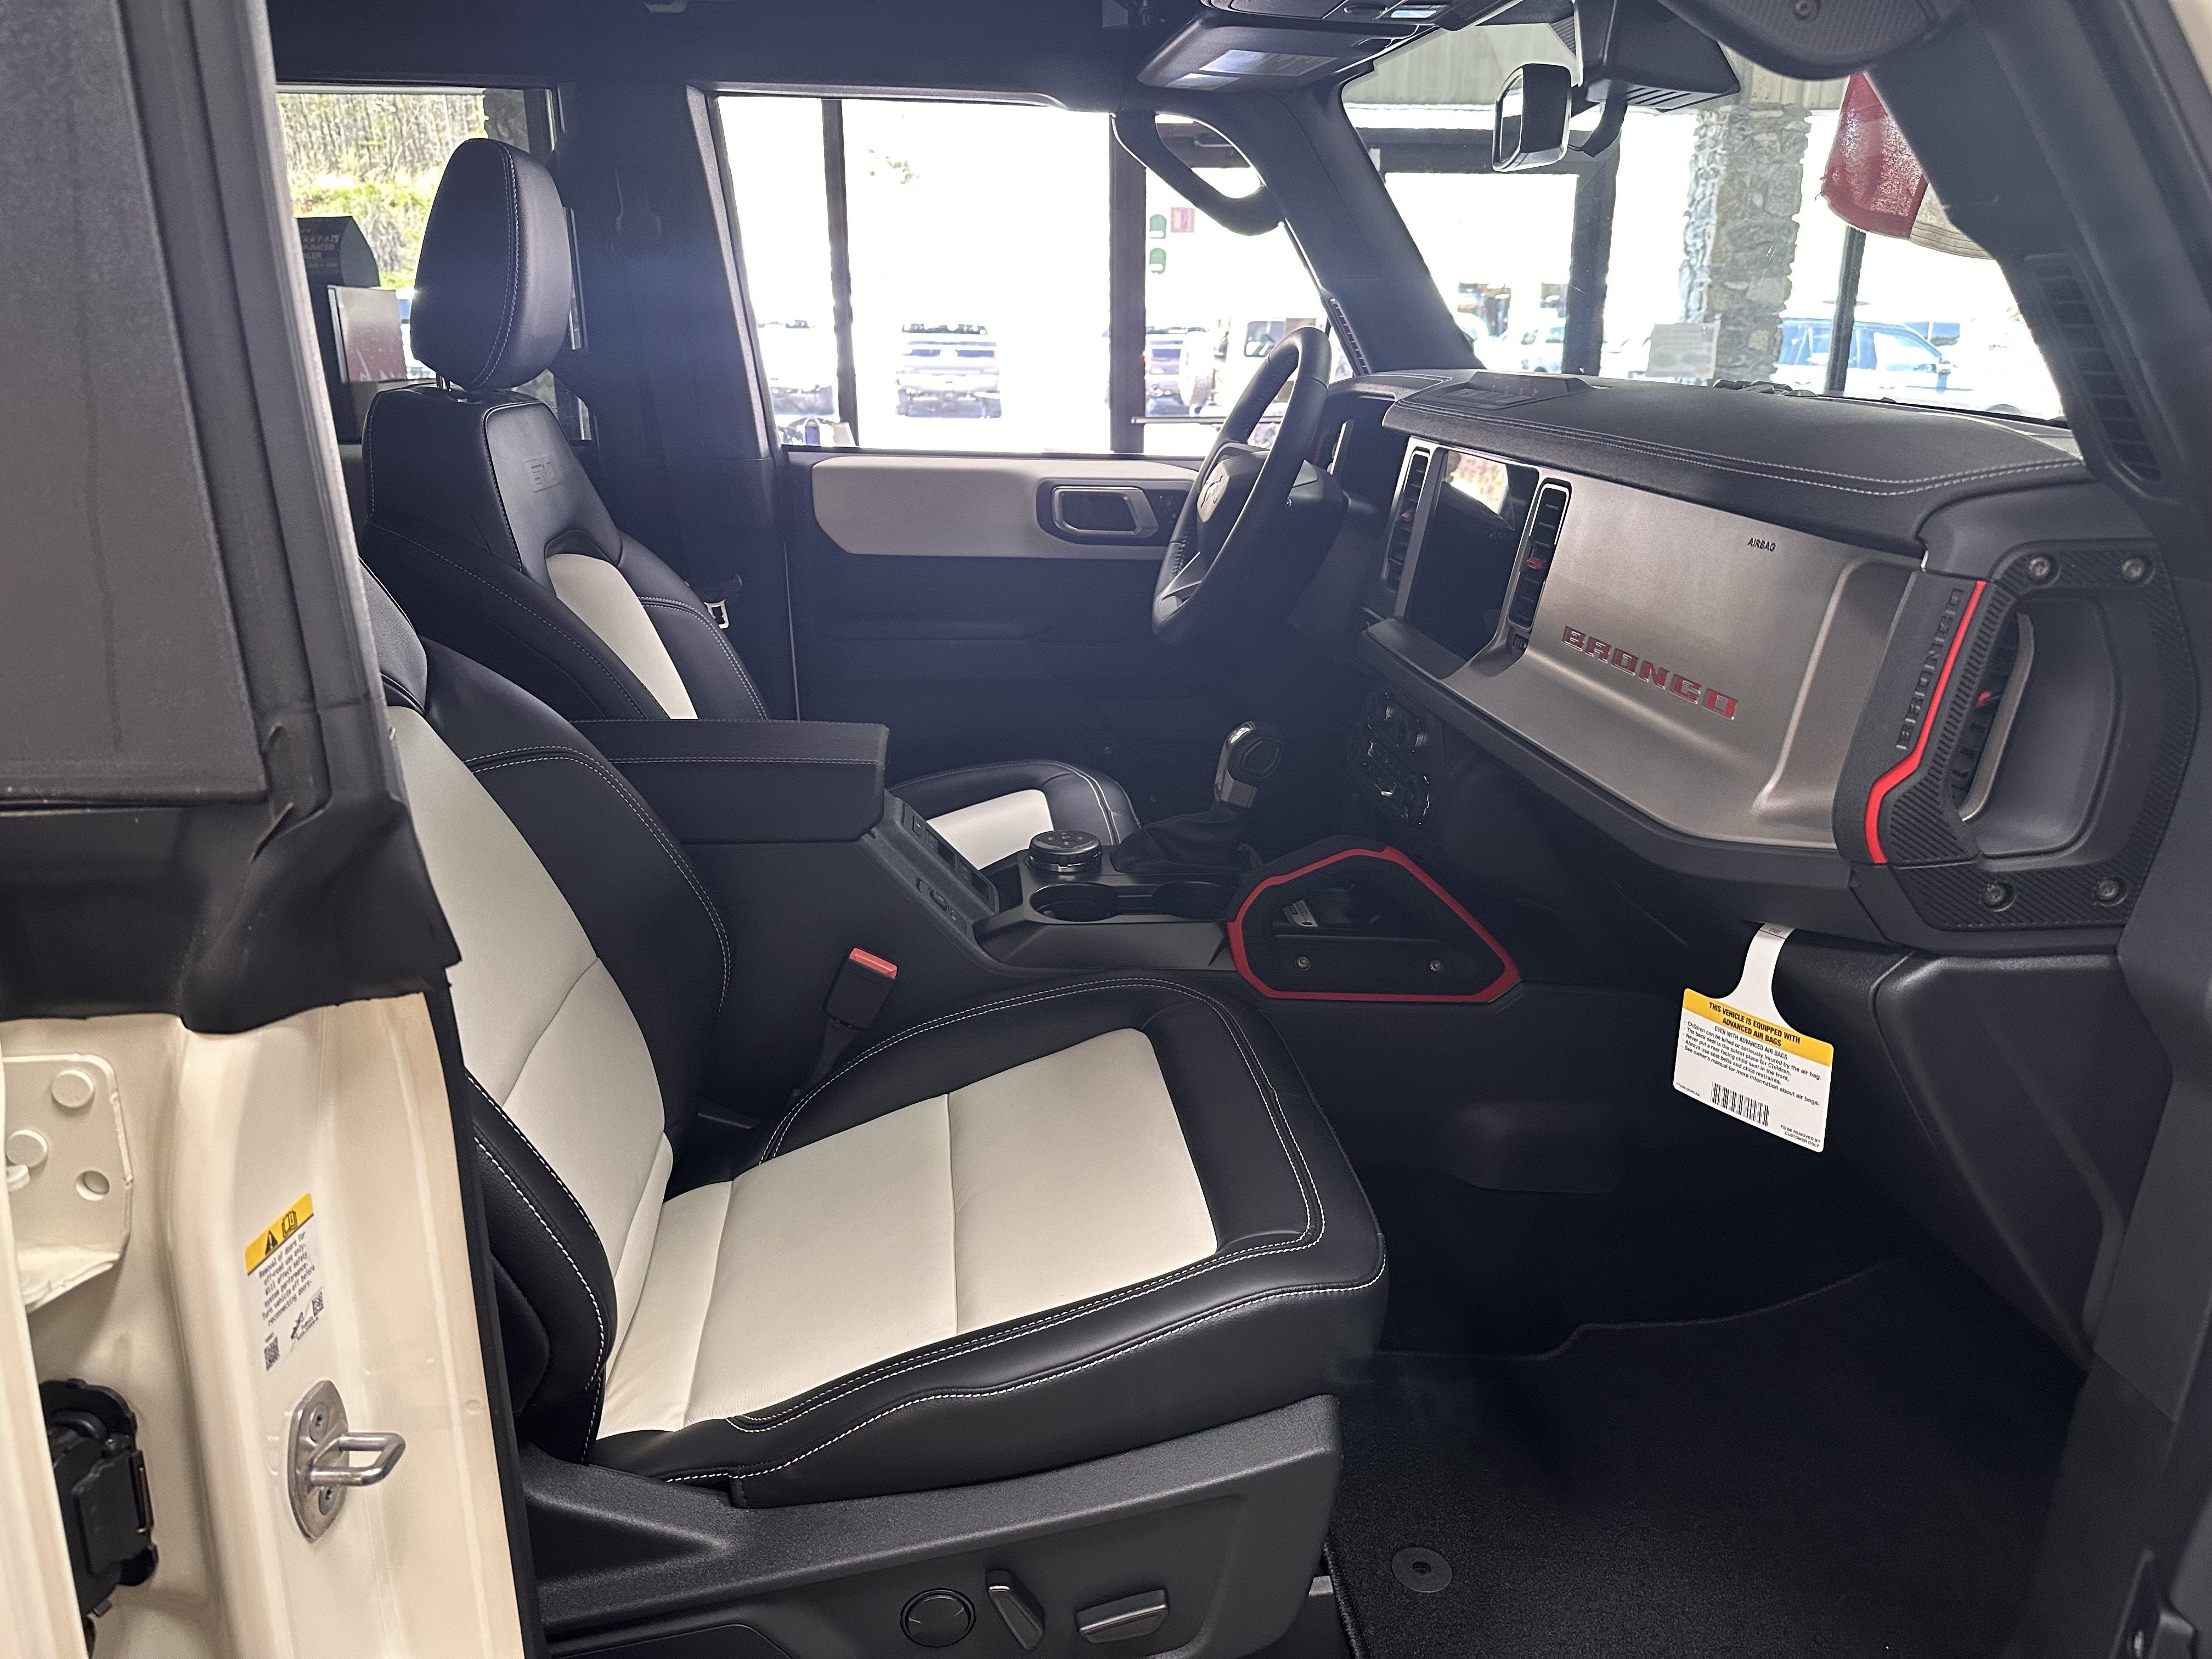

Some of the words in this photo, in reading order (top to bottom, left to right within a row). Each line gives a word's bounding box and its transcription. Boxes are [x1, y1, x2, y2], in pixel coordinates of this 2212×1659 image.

[1747, 538, 1776, 551] AIRBAG
[1562, 626, 1737, 720] BRONCO
[1896, 588, 1965, 750] BRONCO
[1709, 1001, 1721, 1012] THIS
[1722, 1007, 1745, 1023] VEHICLE
[1753, 1020, 1782, 1037] EQUIPPED
[1784, 1031, 1800, 1044] WITH
[1714, 1025, 1725, 1035] EVEN
[1726, 1031, 1738, 1040] WITH
[1739, 1036, 1763, 1050] ADVANCED
[1774, 1050, 1787, 1059] BAGS
[1722, 1017, 1752, 1035] ADVANCED
[1753, 1030, 1763, 1040] AIR
[1764, 1034, 1781, 1046] BAGS
[1686, 1033, 1698, 1042] Never
[1720, 1049, 1735, 1060] facing
[1775, 1071, 1789, 1081] front.
[1687, 1021, 1705, 1033] Children
[1764, 1054, 1782, 1065] injured
[1809, 1071, 1821, 1080] bag.
[1730, 1047, 1744, 1057] safest
[1745, 1054, 1758, 1062] place
[1768, 1062, 1791, 1075] Children.
[1711, 1058, 1728, 1069] manual
[1736, 1069, 1748, 1077] more
[1750, 1074, 1778, 1090] information
[1779, 1087, 1795, 1097] about
[1804, 1096, 1819, 1106] bags.
[1756, 1071, 1781, 1085] restraints.
